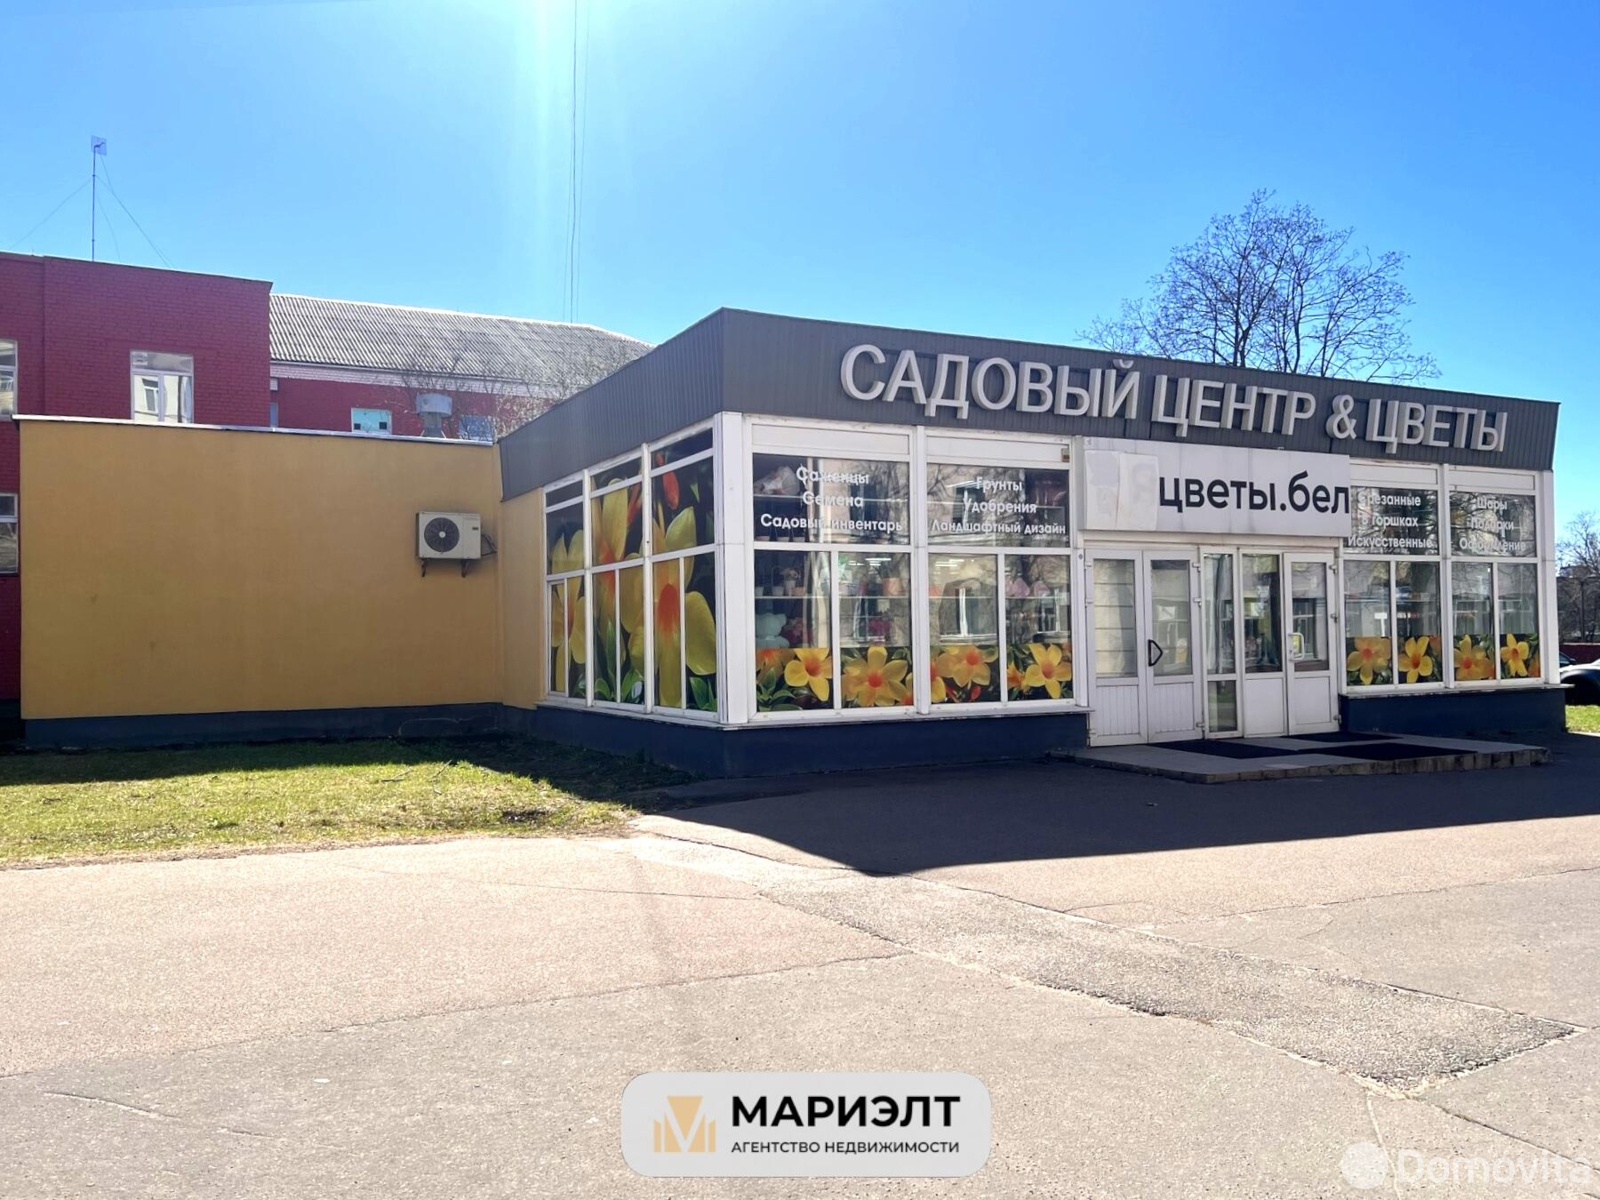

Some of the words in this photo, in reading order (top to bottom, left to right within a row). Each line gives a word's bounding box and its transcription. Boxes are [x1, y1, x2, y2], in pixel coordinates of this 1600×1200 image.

[840, 344, 1141, 420] САДОВЫЙ
[1151, 374, 1317, 438] ЦЕНТР
[1326, 394, 1357, 440] &
[1365, 398, 1509, 454] ЦВЕТЫ
[795, 465, 870, 486] Саженцы
[976, 476, 1023, 494] Грунты
[1158, 470, 1351, 514] цветы.бел
[802, 491, 865, 508] Семена
[963, 496, 1038, 515] Удобрения
[1357, 490, 1422, 507] Срезанные
[1476, 496, 1508, 512] Шары
[831, 518, 903, 535] инвентарь
[931, 517, 1021, 535] Ландшафтный
[1024, 521, 1066, 536] дизайн
[1372, 516, 1419, 529] горшках
[1470, 516, 1514, 533] Подарки
[1347, 534, 1433, 550] Искусственные
